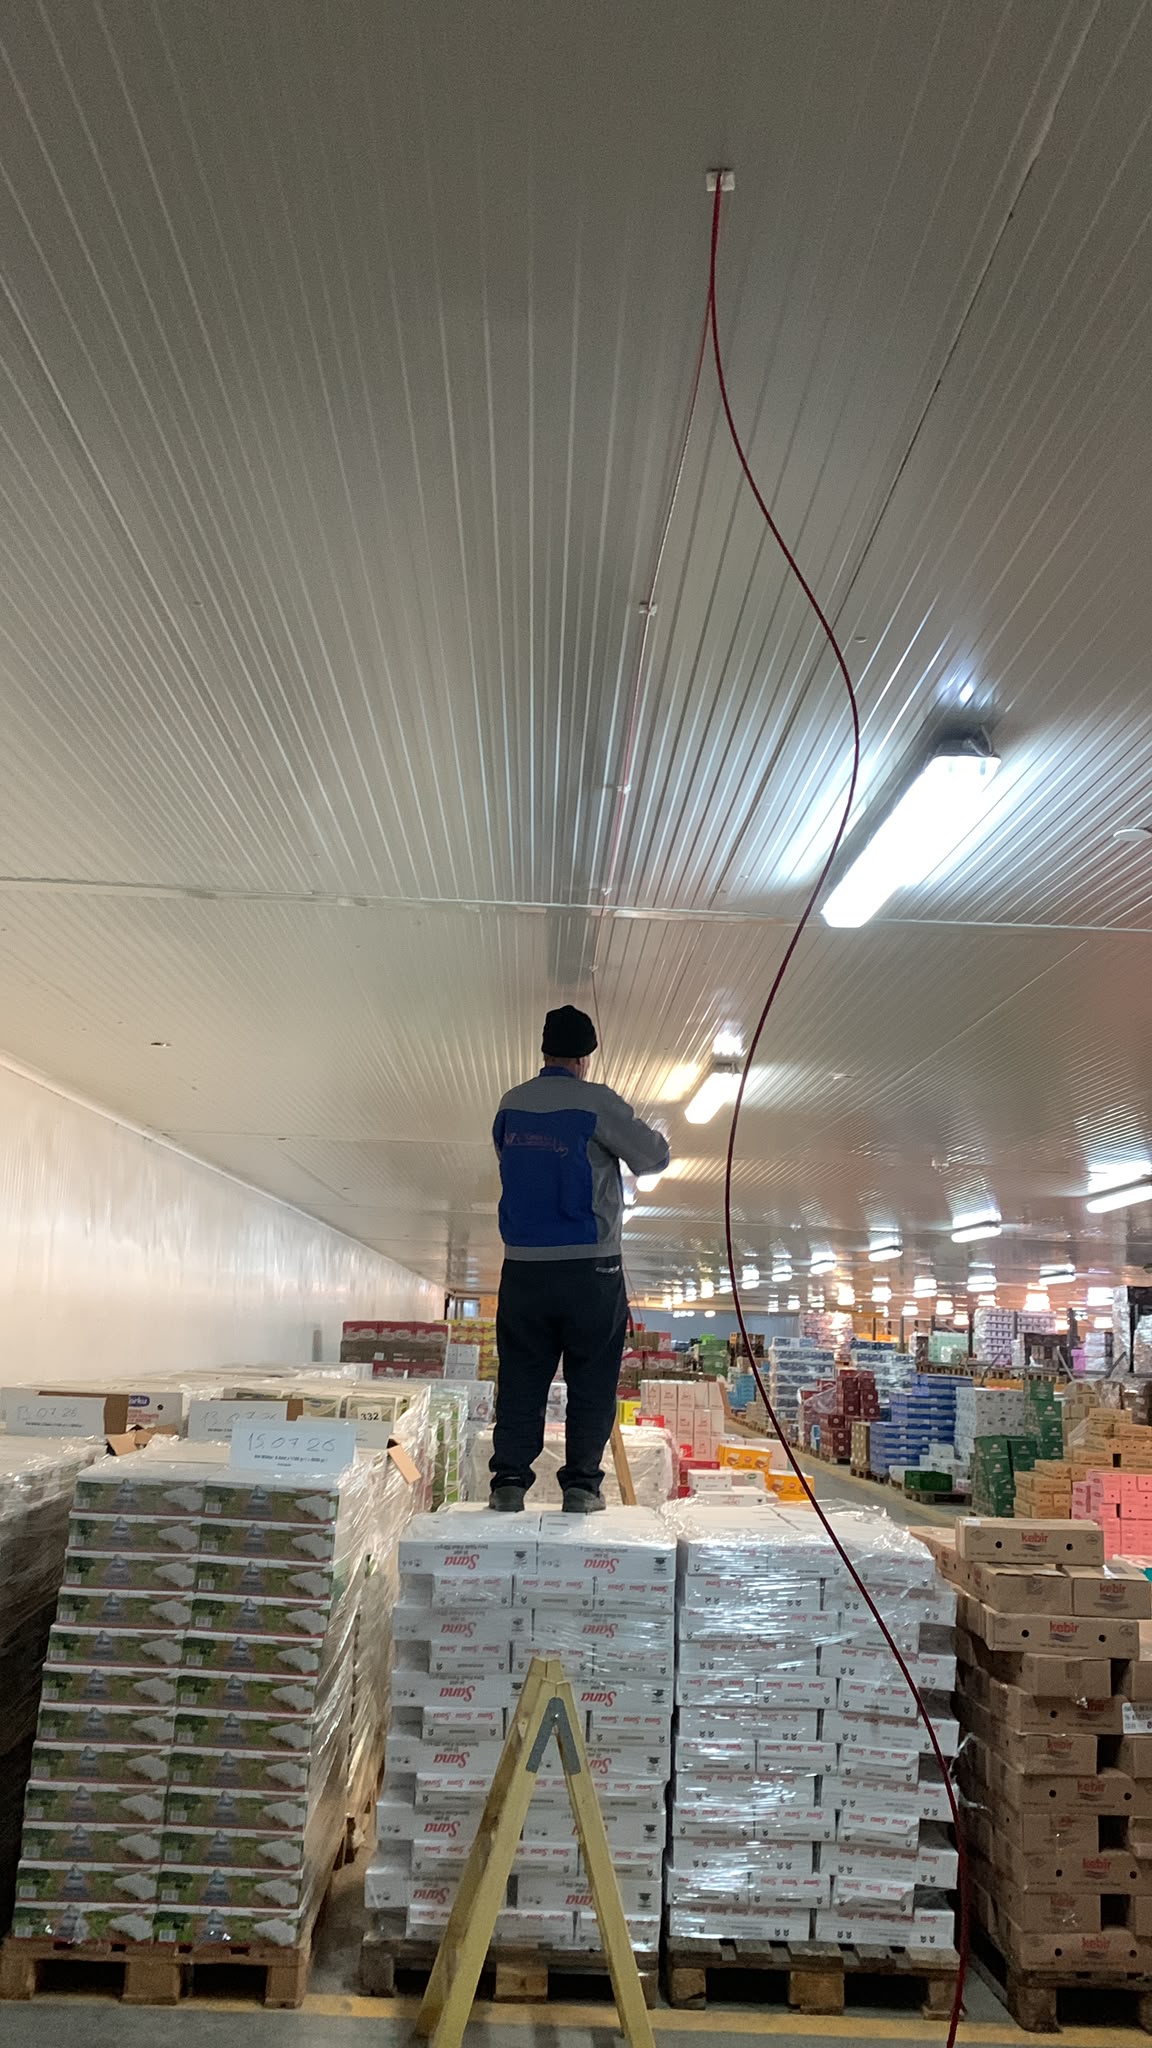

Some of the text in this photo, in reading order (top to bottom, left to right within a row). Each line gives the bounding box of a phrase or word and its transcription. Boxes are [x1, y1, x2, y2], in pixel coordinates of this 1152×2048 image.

[360, 1412, 379, 1421] 332
[1021, 1532, 1048, 1543] kebir
[444, 1552, 480, 1570] Sana
[584, 1557, 620, 1574] Sana
[441, 1622, 477, 1638] Sana
[582, 1623, 618, 1638] Sana
[1049, 1621, 1079, 1633] kebir
[440, 1685, 476, 1702] Sana
[581, 1690, 617, 1708] Sana
[433, 1751, 470, 1768] Sana
[589, 1757, 613, 1774] Sa
[424, 1821, 461, 1838] Sana
[413, 1887, 450, 1904] Sana
